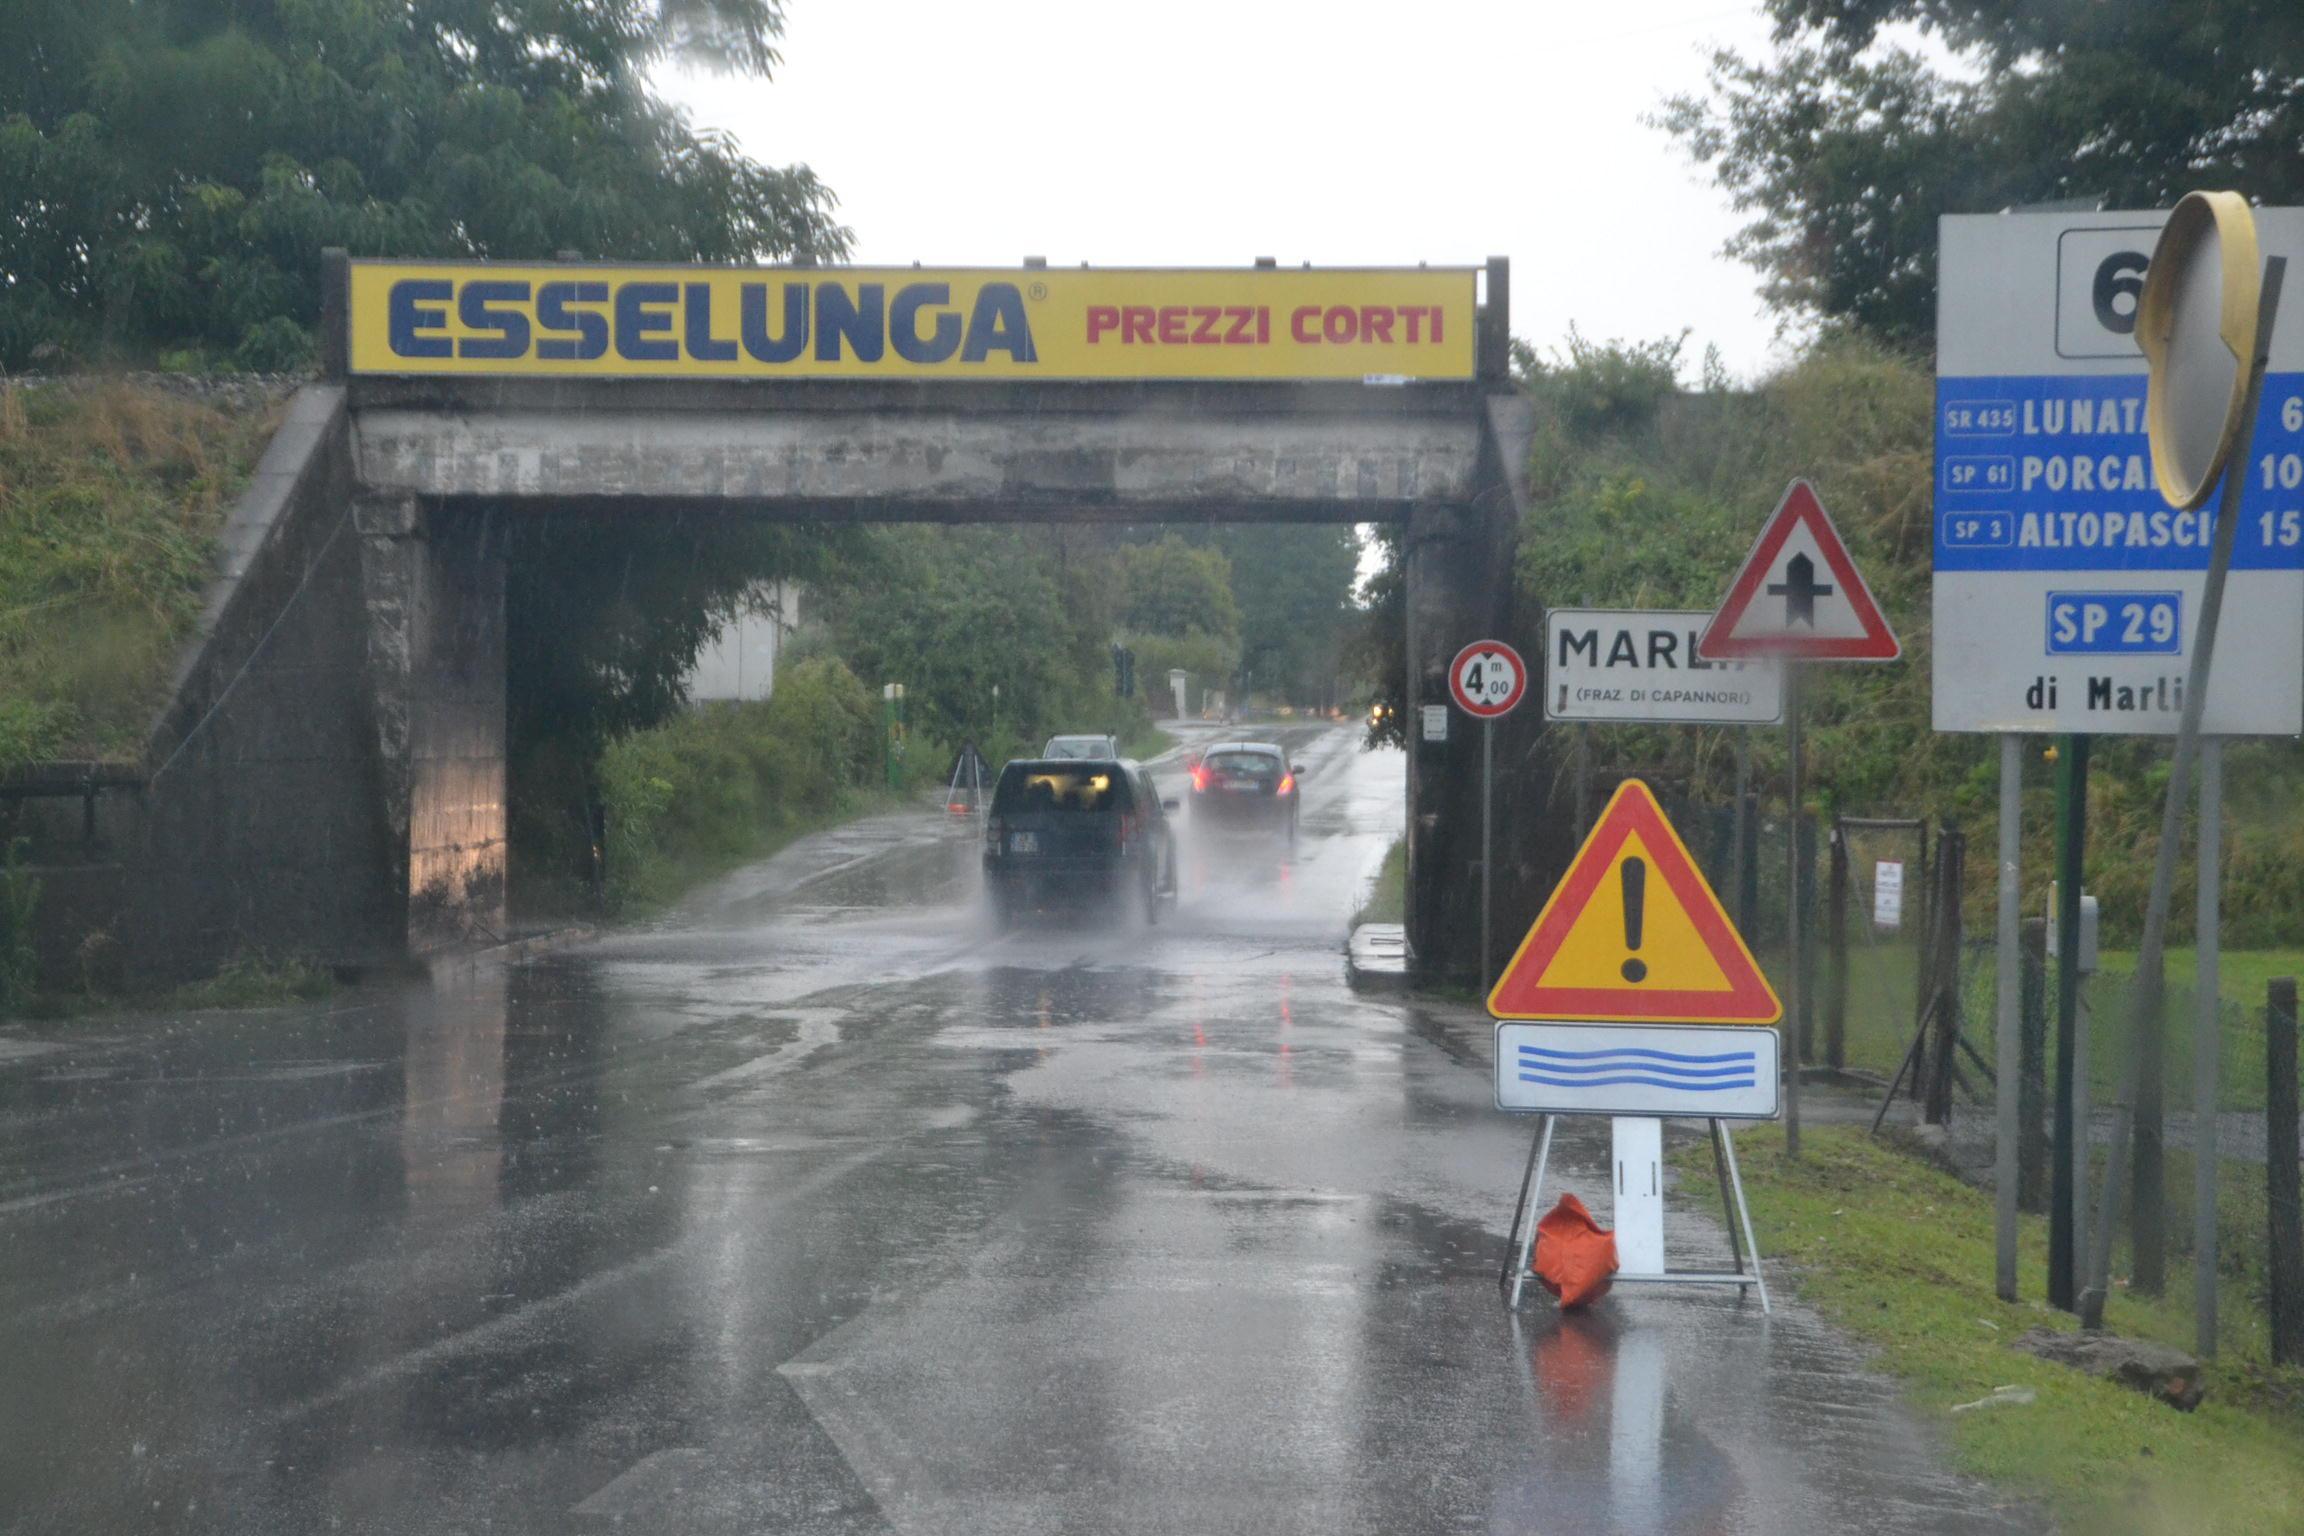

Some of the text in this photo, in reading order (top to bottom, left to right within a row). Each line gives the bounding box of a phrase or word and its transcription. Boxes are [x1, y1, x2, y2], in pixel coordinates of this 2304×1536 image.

[2092, 250, 2150, 334] 6
[1086, 304, 1270, 344] PREZZI
[1290, 304, 1444, 344] CORTI
[1948, 410, 1972, 428] SR
[1977, 408, 2014, 428] 435
[2281, 396, 2303, 432] 6
[1952, 453, 2303, 491] SP 61 PORCA 10
[1955, 510, 2300, 547] SP 3 ALTOPASCI 15
[2054, 603, 2175, 643] SP 29
[1491, 662, 1502, 672] m
[2026, 676, 2190, 712] di Marli
